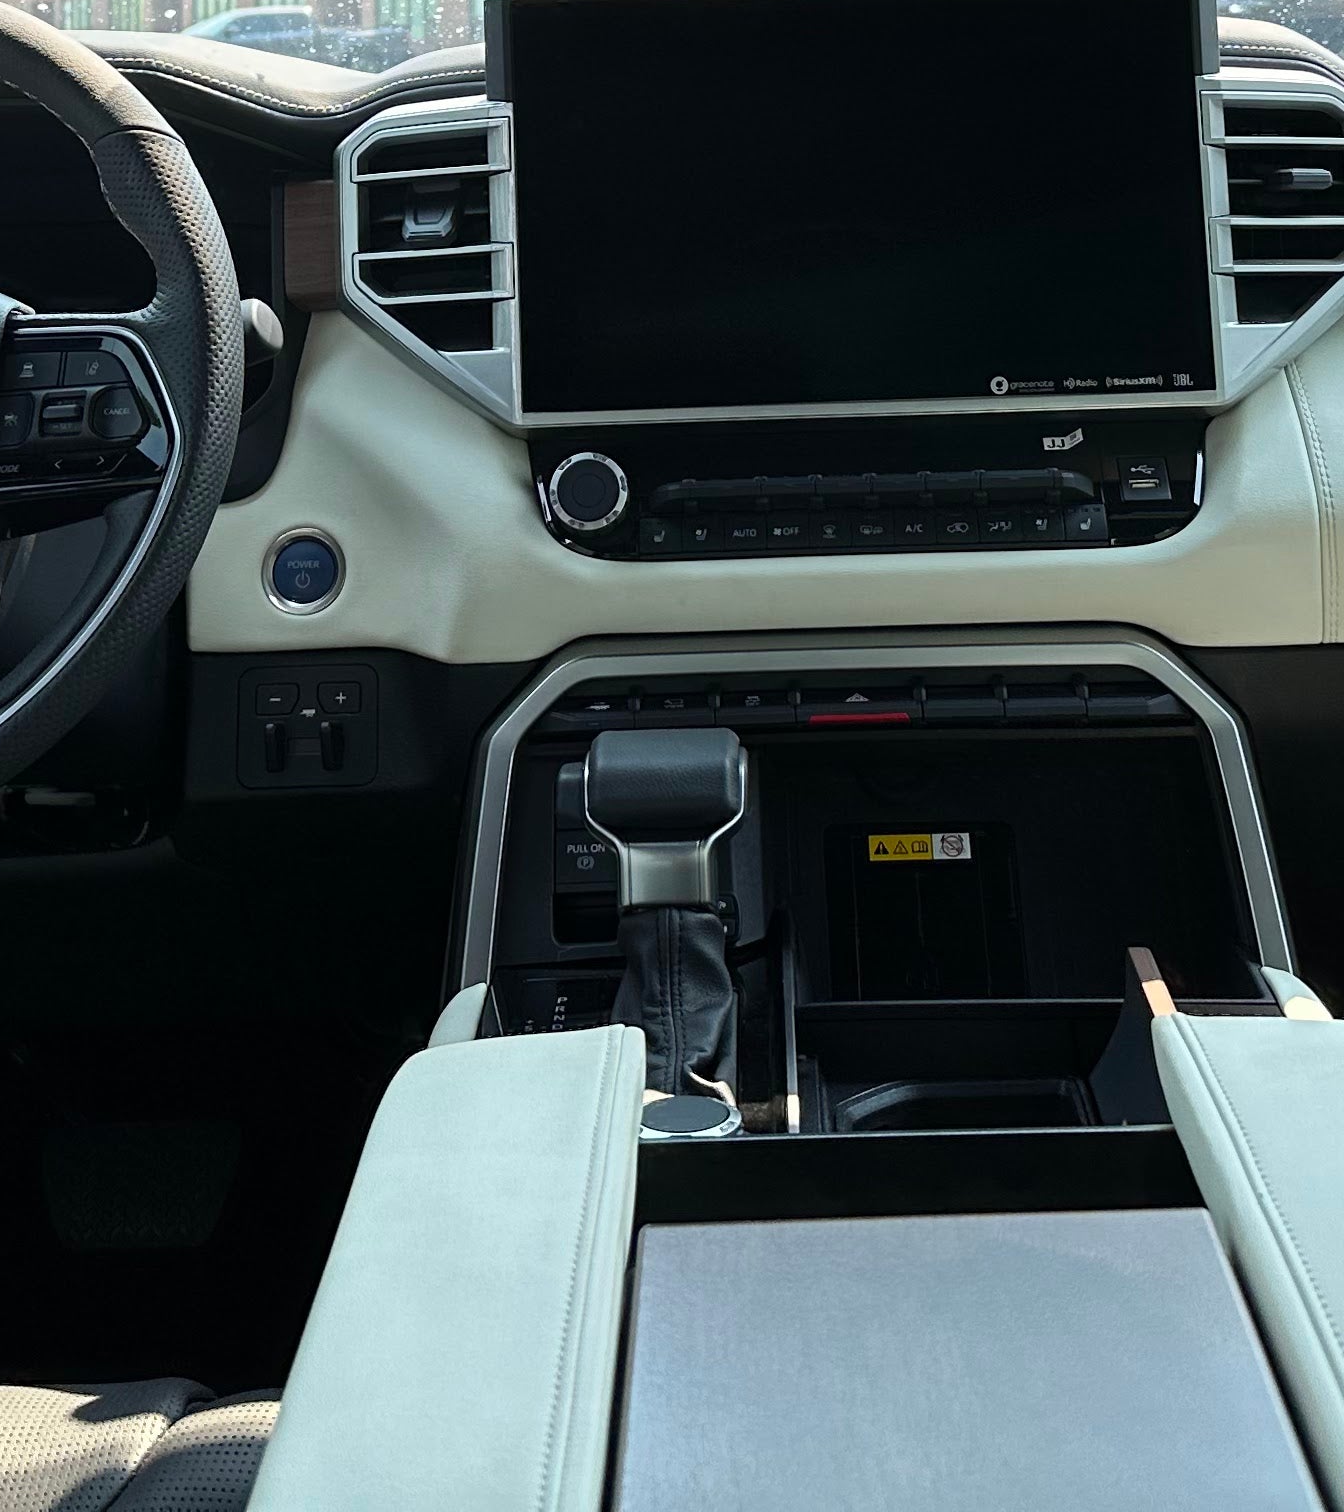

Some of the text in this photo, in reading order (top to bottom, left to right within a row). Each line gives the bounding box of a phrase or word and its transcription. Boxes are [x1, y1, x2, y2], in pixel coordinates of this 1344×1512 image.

[1173, 373, 1194, 386] JBL
[731, 528, 757, 538] AUTO
[783, 526, 800, 536] OFF
[905, 524, 923, 533] A/C
[287, 560, 320, 569] POWER
[567, 843, 606, 854] PULL ON
[557, 996, 568, 1004] P
